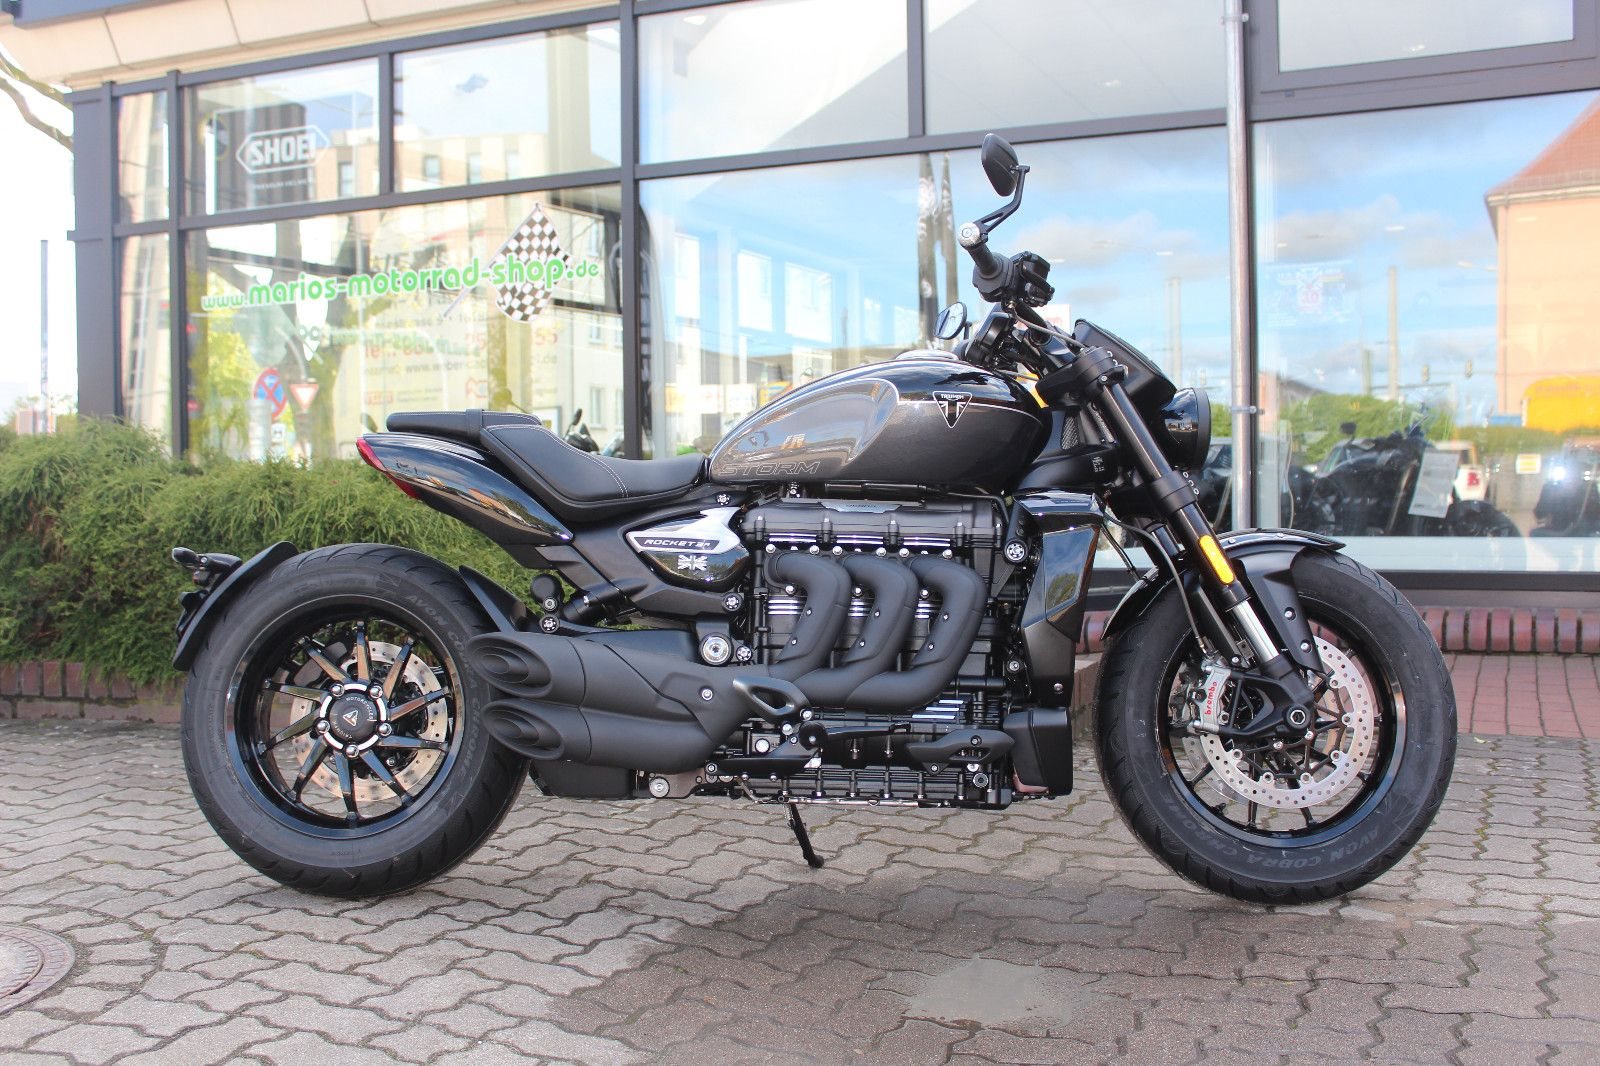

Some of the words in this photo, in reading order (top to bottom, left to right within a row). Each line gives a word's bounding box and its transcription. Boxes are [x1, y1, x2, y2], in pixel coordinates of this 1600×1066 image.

[248, 133, 317, 167] SHOEI
[202, 254, 600, 310] www.marios-motorrad-shop.de
[718, 462, 820, 476] STORM
[405, 595, 447, 627] AVON
[1205, 682, 1217, 715] brembo
[1246, 853, 1321, 869] COBRA
[1329, 828, 1379, 862] AVON
